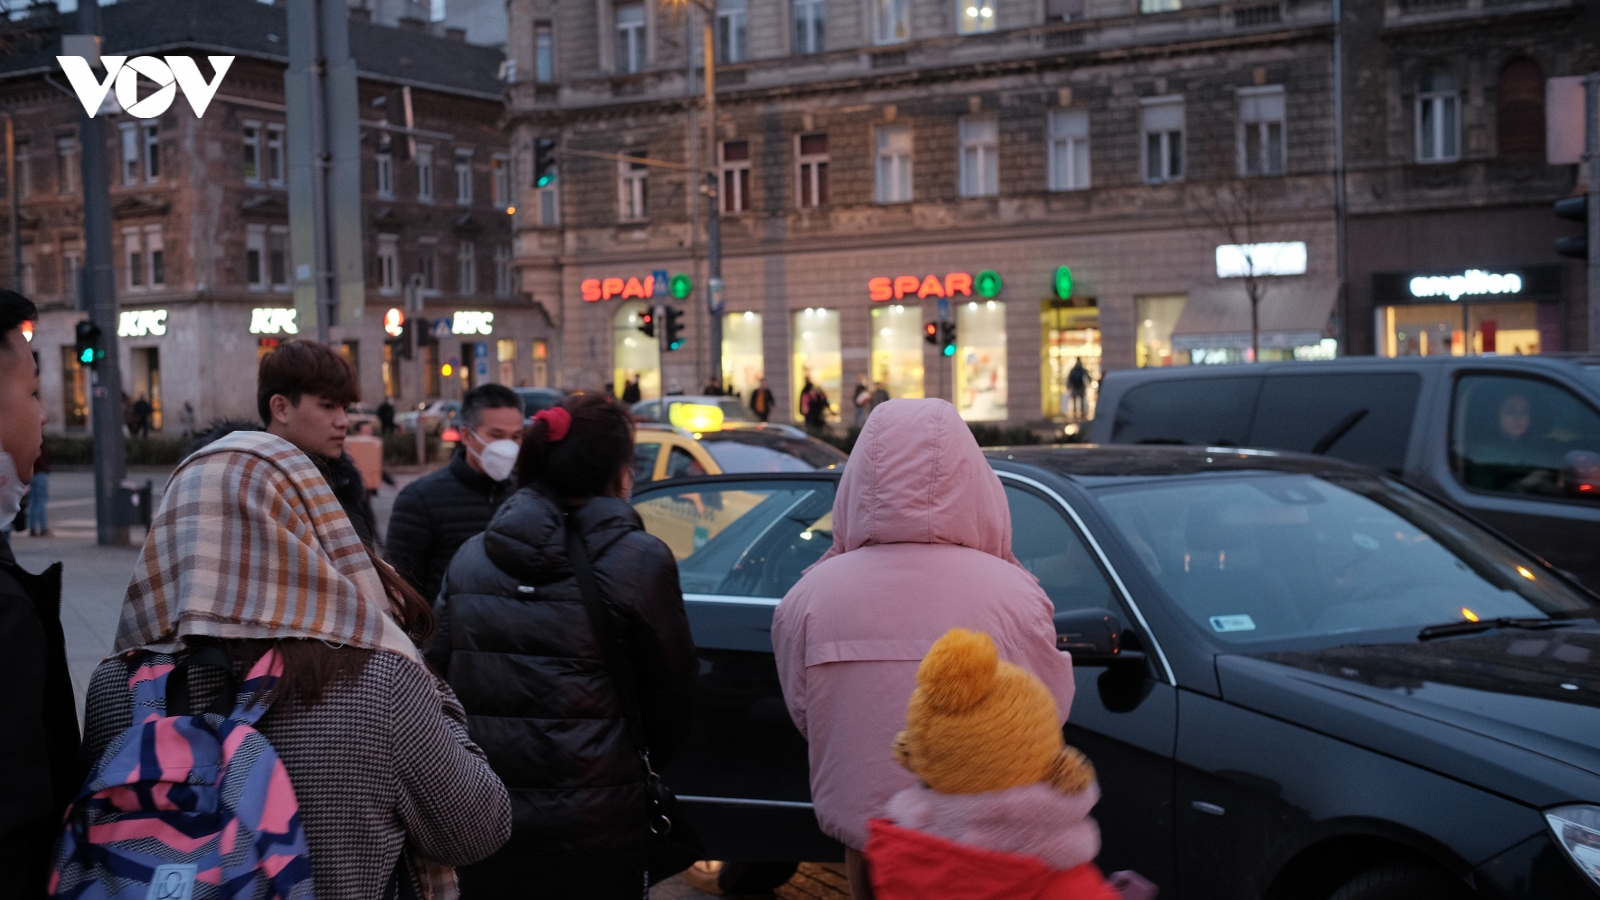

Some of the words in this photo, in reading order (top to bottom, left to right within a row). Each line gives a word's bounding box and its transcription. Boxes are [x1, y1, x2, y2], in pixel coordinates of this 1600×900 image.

[868, 272, 972, 301] SPAR
[118, 310, 167, 336] KFC
[250, 308, 298, 334] KFC
[452, 311, 493, 334] KFC
